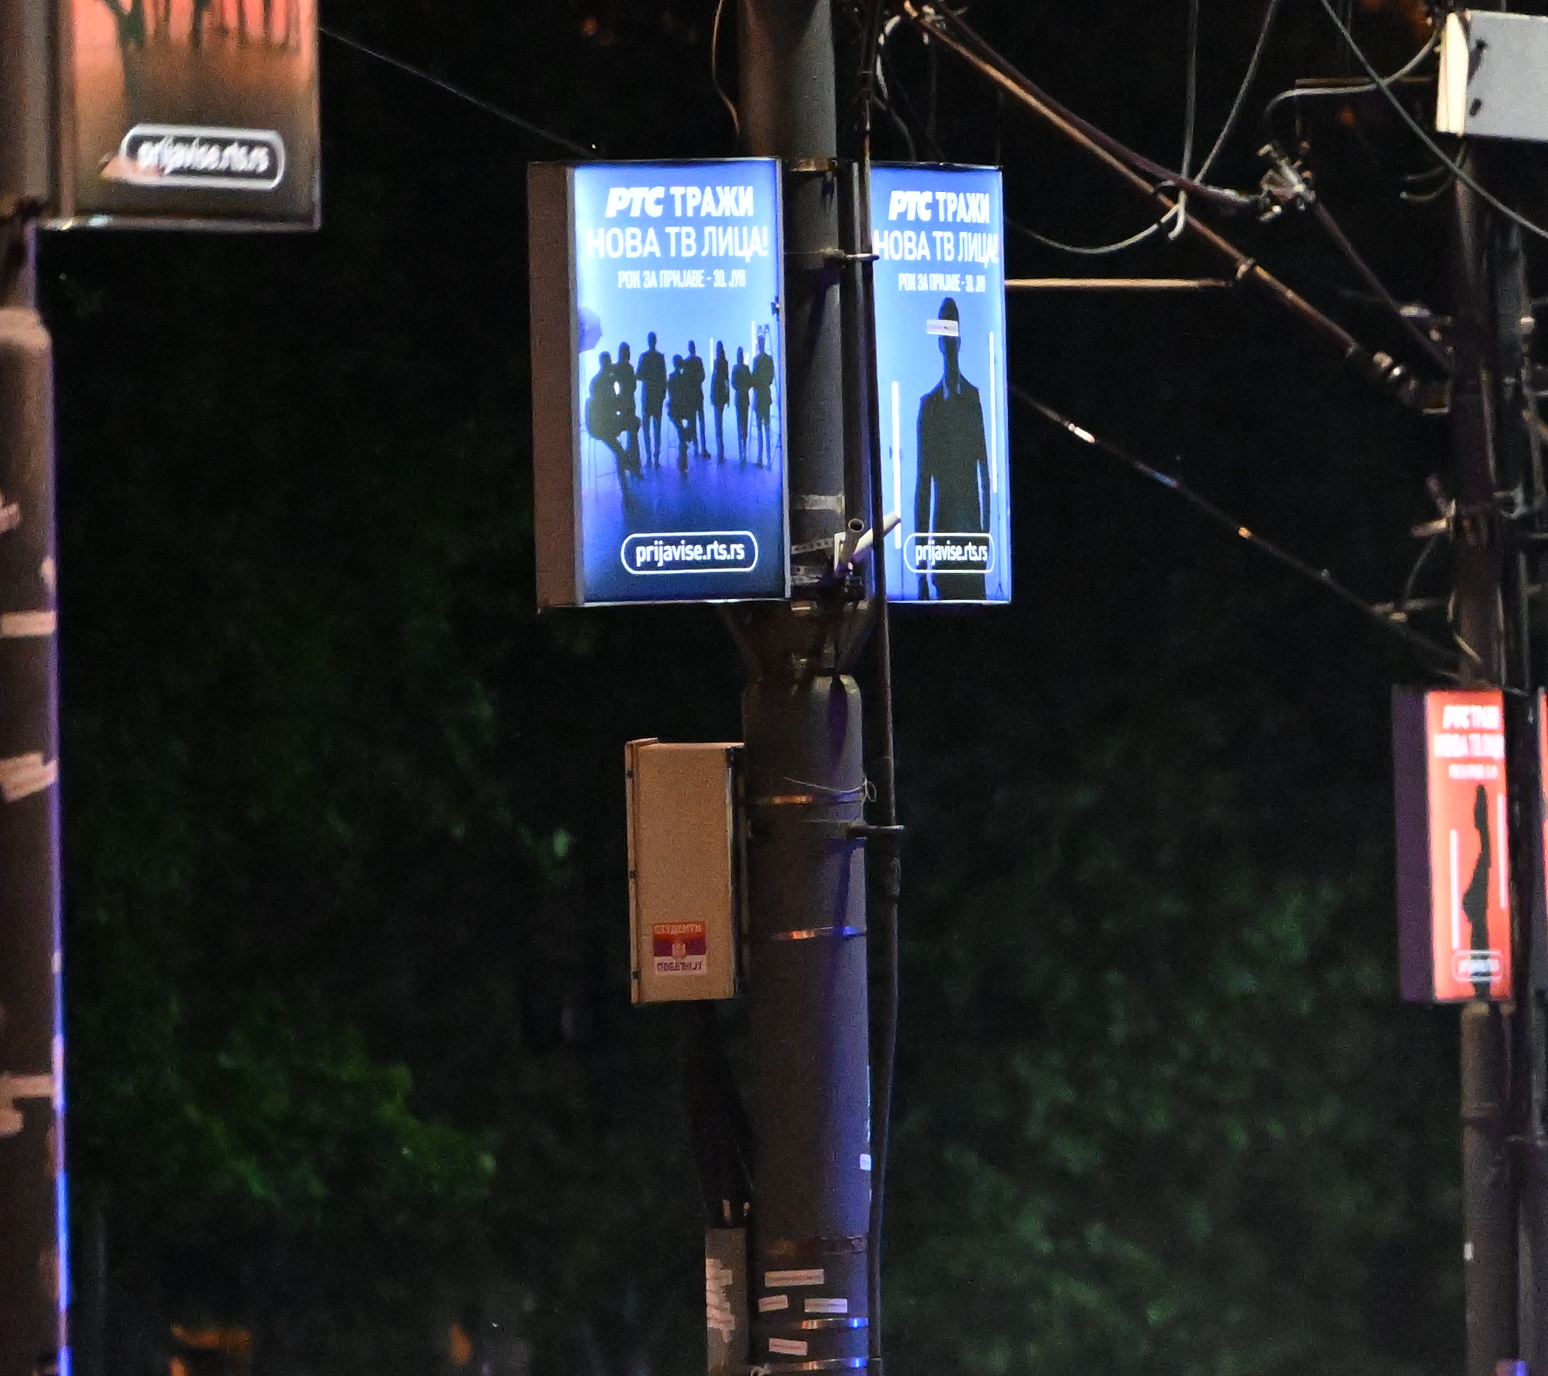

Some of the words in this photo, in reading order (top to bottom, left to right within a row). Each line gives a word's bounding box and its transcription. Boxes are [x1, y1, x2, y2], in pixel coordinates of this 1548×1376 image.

[605, 186, 665, 218] РТС
[669, 186, 754, 217] ТРАЖИ
[888, 190, 933, 221] РТС
[935, 192, 990, 224] ТРАЖИ
[586, 226, 661, 259] НОВА
[665, 226, 697, 257] ТВ
[700, 226, 768, 262] ЛИЦА!
[873, 230, 931, 261] НОВА
[932, 231, 955, 261] ТВ
[618, 270, 641, 289] РОК
[643, 270, 657, 288] ЗА
[659, 269, 705, 288] ПРИЈАВЕ
[635, 540, 745, 567] prijavise.rts.rs
[915, 540, 989, 566] prijavise.rts.rs
